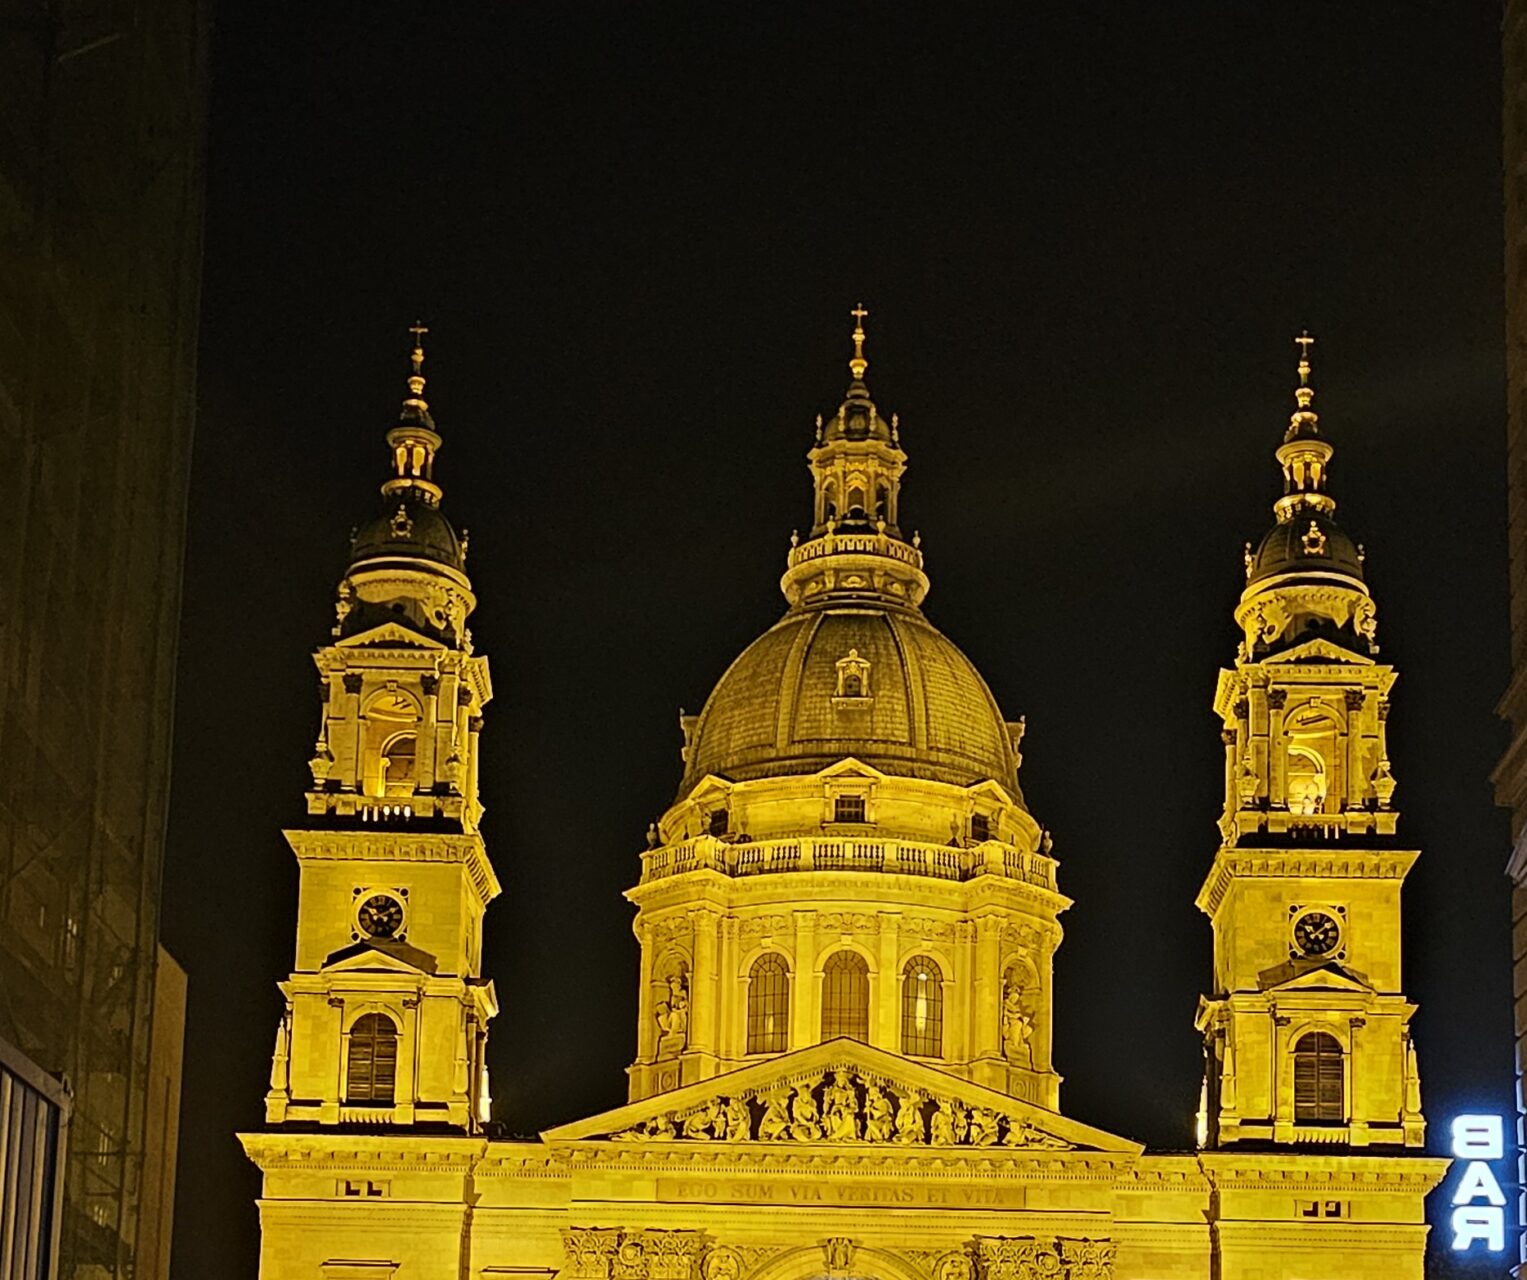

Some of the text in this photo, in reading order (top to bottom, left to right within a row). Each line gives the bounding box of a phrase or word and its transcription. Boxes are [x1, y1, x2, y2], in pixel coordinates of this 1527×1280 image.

[677, 1182, 1005, 1205] EGO SUM VIA VERITAS ET VITA
